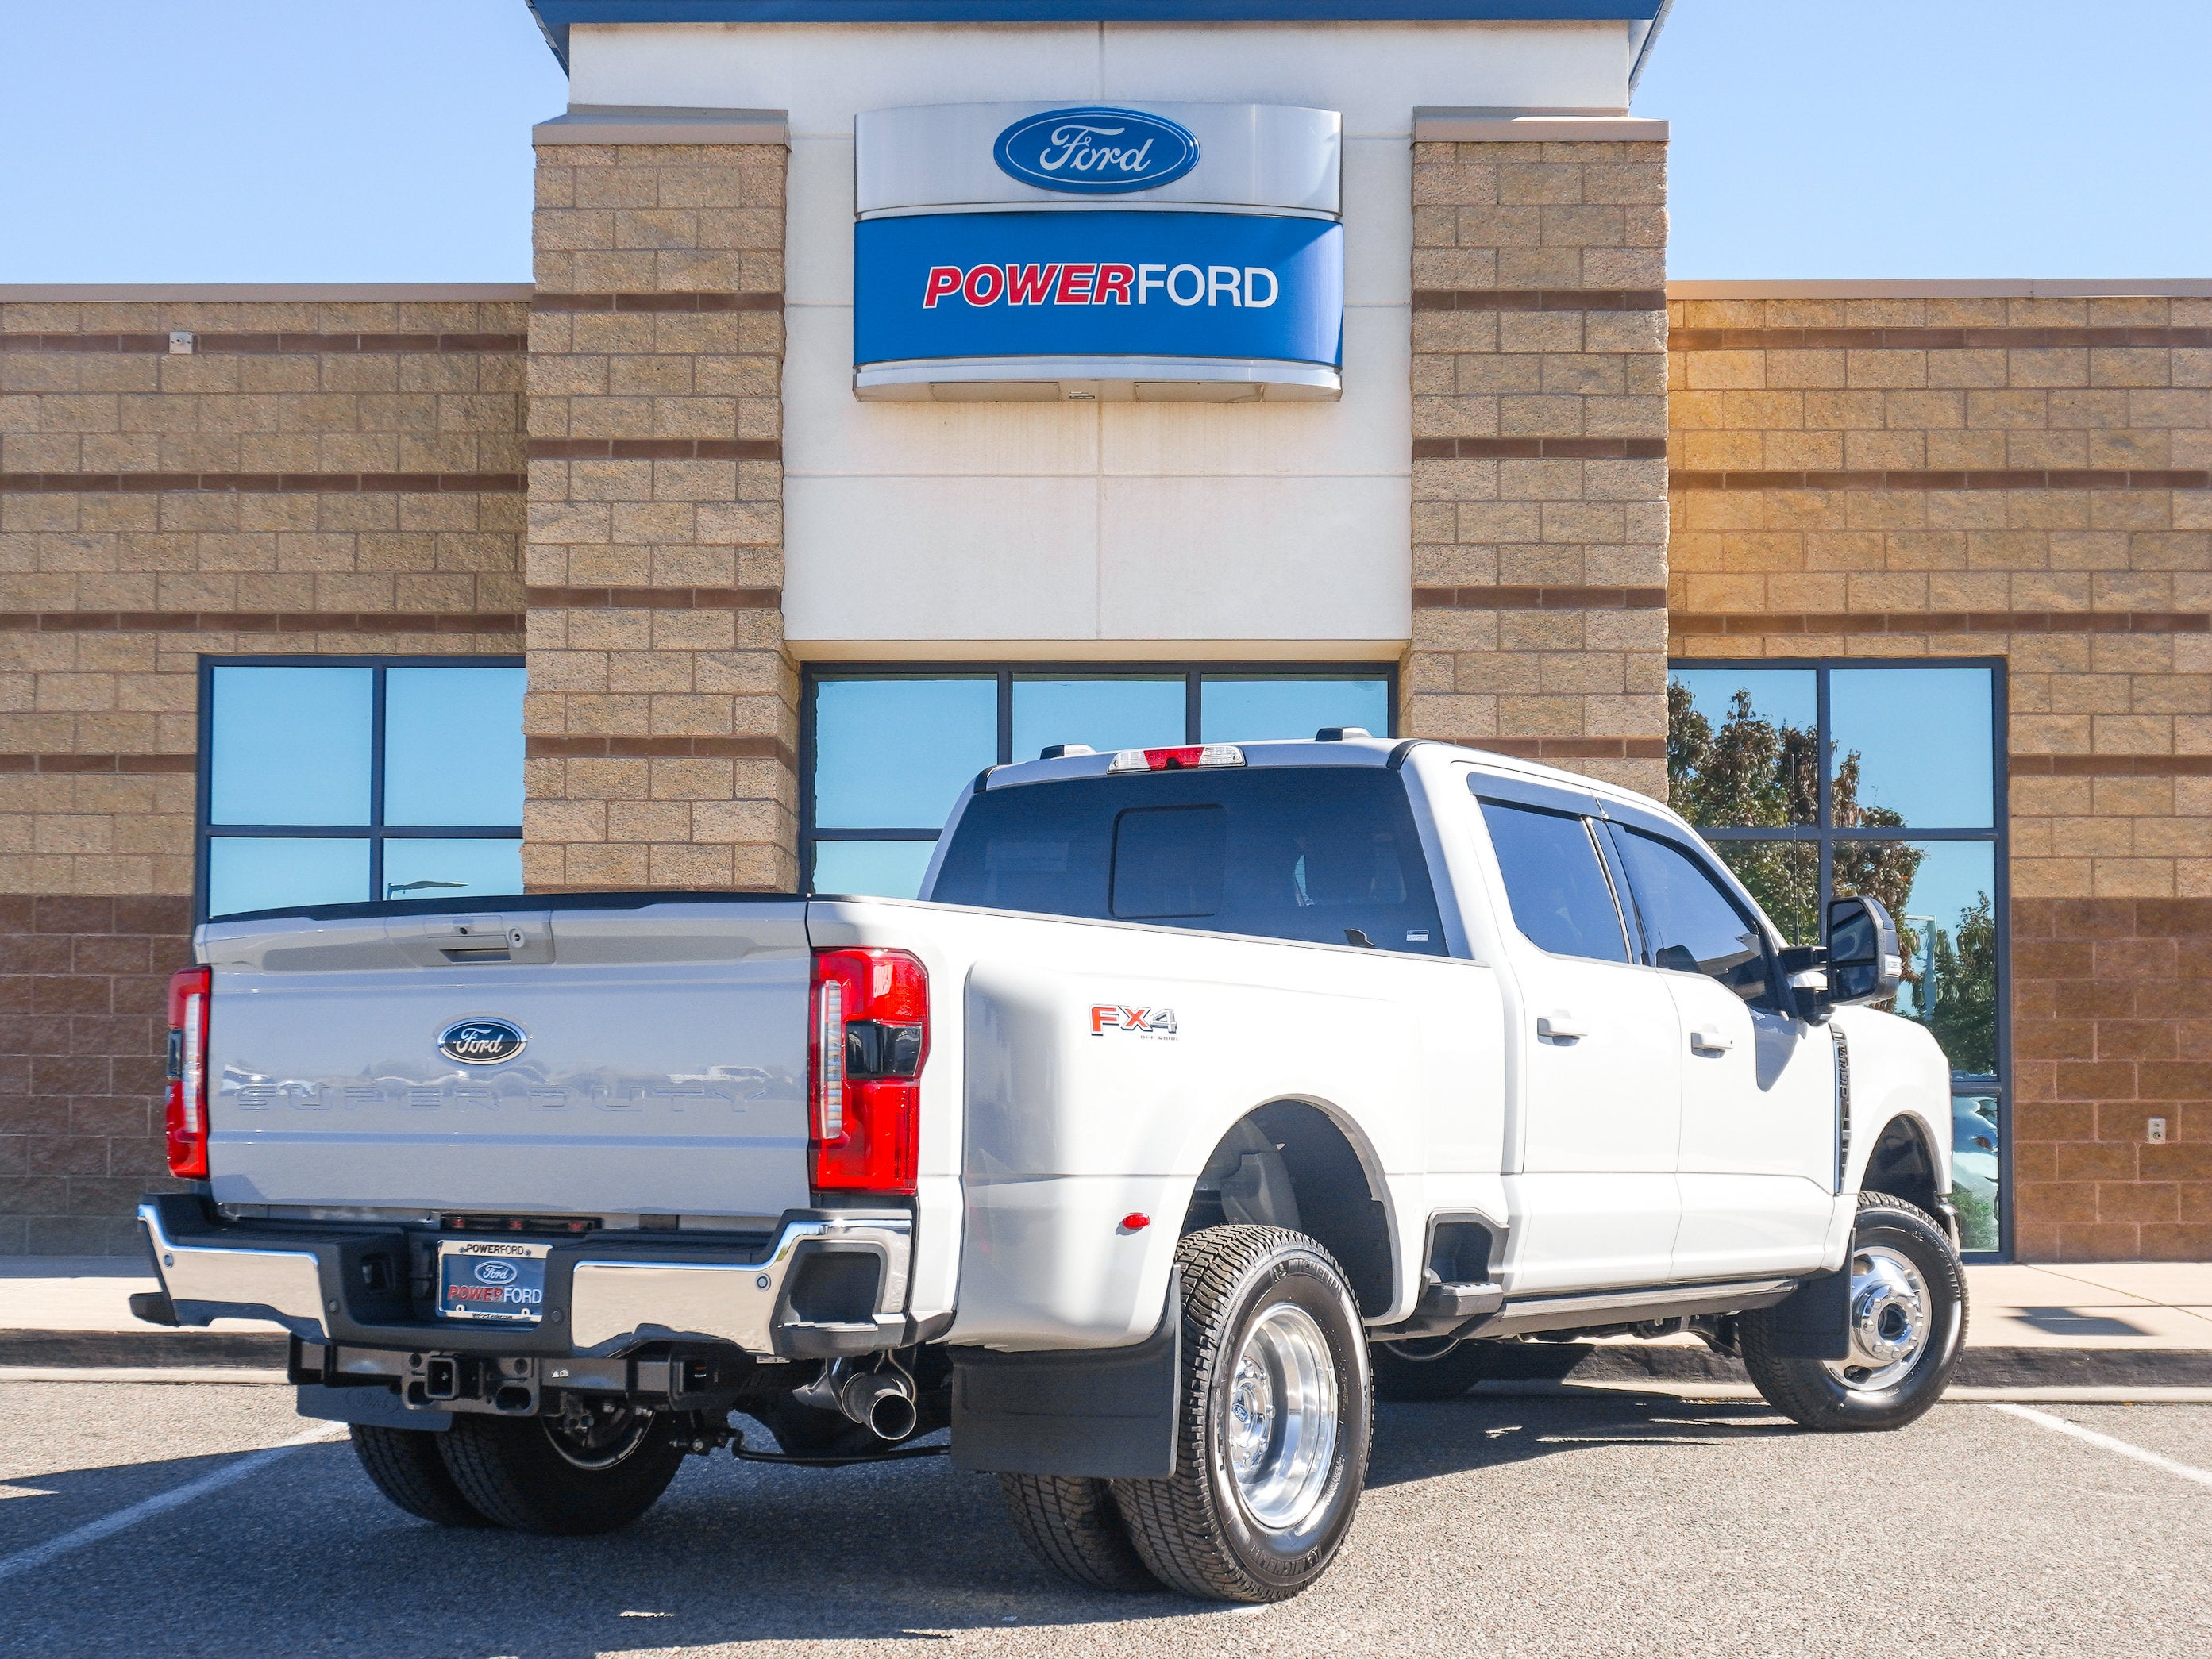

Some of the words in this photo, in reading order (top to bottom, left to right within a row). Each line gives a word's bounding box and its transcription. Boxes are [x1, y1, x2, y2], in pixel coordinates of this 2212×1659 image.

[1039, 125, 1154, 172] Ford
[923, 263, 1279, 309] POWERFORD
[1089, 1003, 1177, 1037] FX4
[456, 1027, 504, 1053] Ford
[237, 1086, 501, 1111] SUPER
[527, 1086, 766, 1112] DUTY
[466, 1244, 524, 1255] POWERFORD
[483, 1265, 508, 1280] Ford
[1288, 1258, 1342, 1300] MICHELIN
[448, 1285, 543, 1304] POWERFORD
